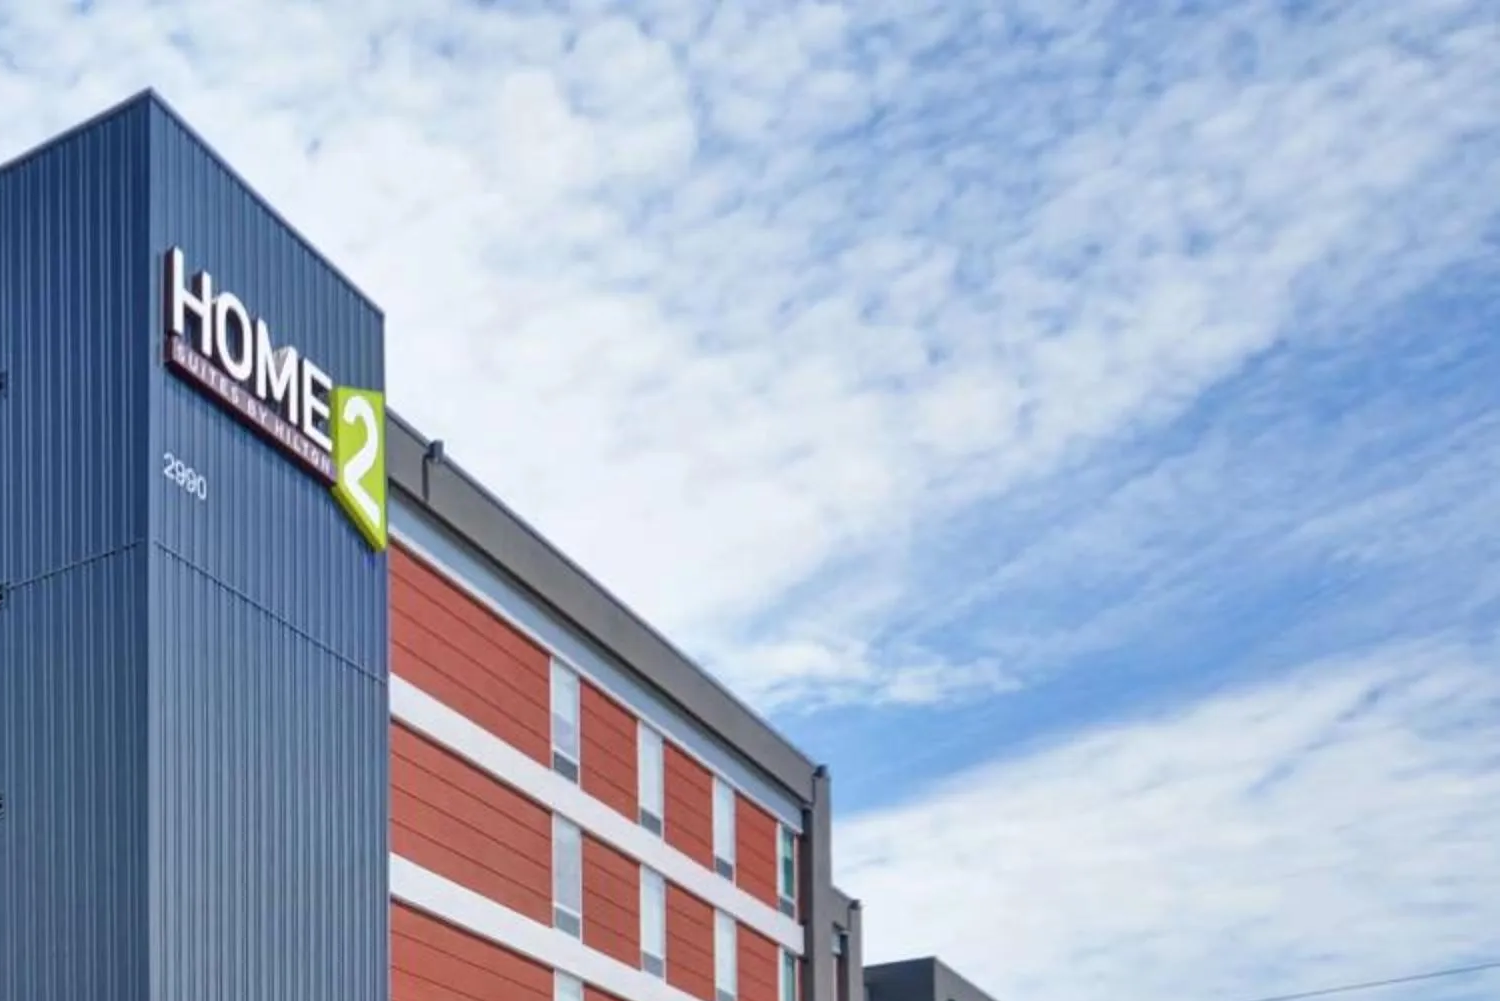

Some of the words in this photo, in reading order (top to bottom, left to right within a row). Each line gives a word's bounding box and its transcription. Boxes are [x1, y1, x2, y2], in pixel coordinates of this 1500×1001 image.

[171, 245, 333, 451] HOME
[342, 395, 381, 530] 2
[174, 343, 239, 405] SUITES
[247, 399, 267, 423] BY
[275, 420, 331, 475] HILTON
